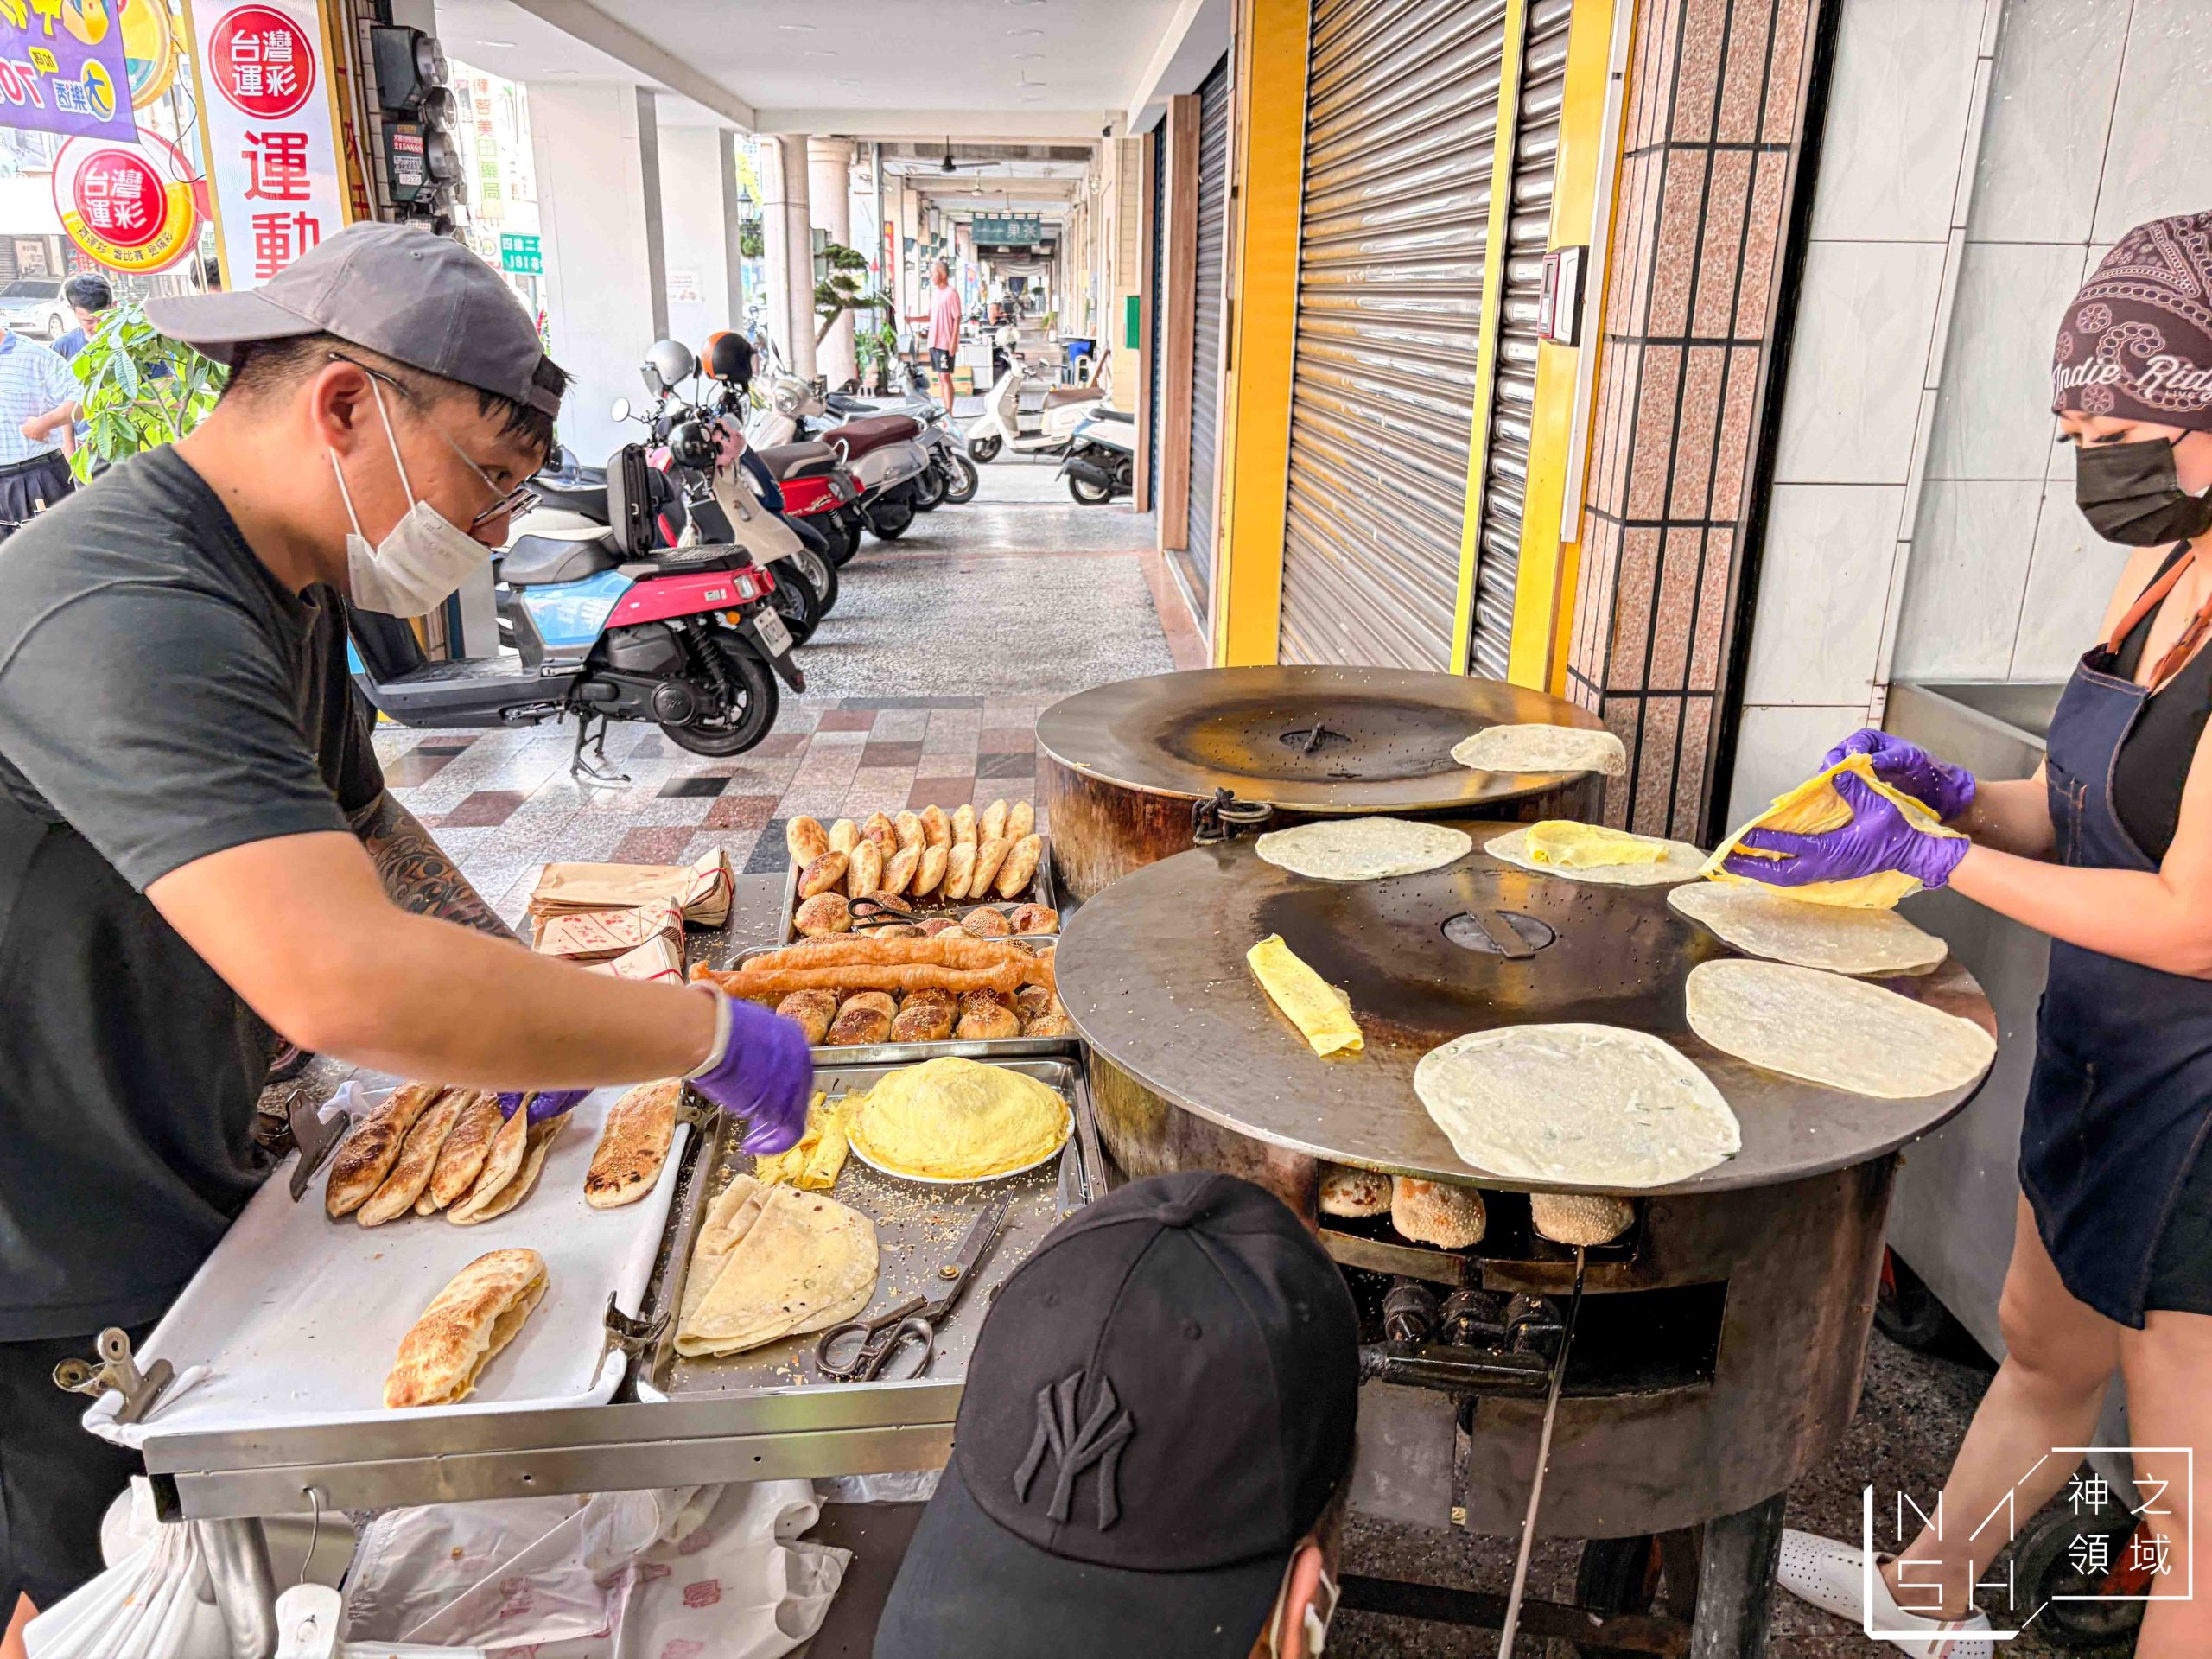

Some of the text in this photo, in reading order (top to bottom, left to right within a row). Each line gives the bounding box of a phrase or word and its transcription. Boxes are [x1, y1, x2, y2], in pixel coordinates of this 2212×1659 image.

[231, 29, 293, 63] 台灣
[232, 64, 298, 97] 運彩
[84, 161, 144, 199] 台灣
[86, 199, 148, 230] 運彩
[241, 130, 321, 280] 運動
[502, 238, 540, 252] 四維二
[2052, 355, 2212, 404] Indie Rid
[1014, 1369, 1135, 1532] NY
